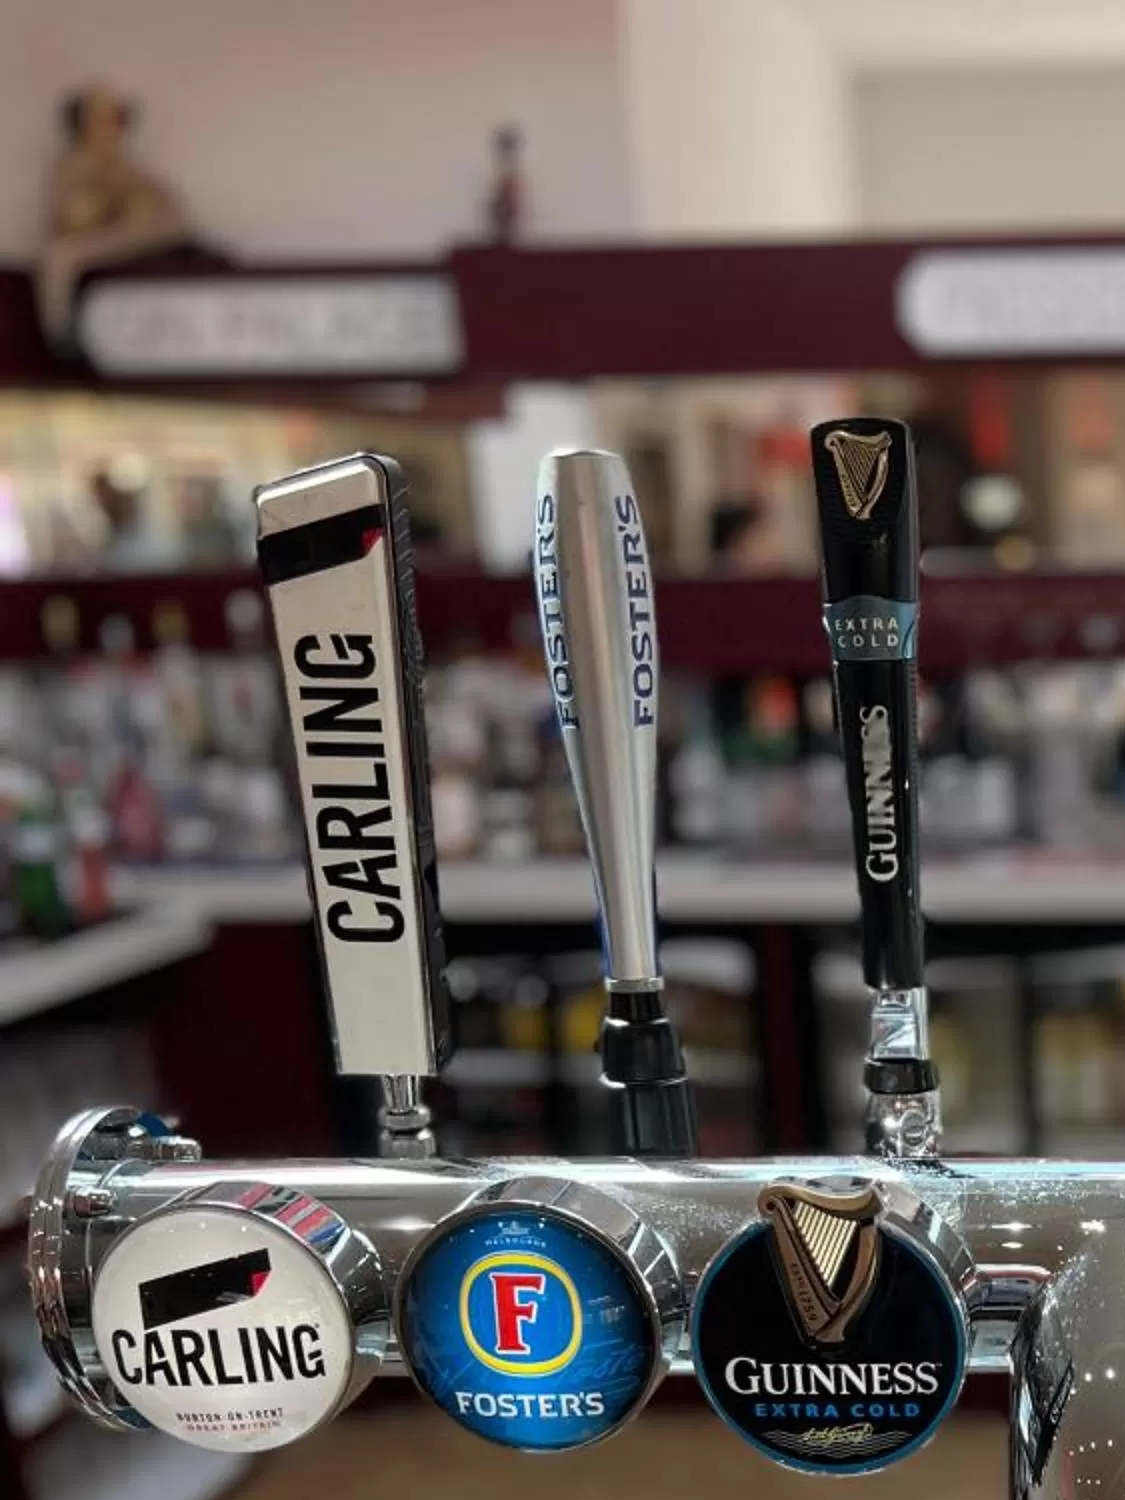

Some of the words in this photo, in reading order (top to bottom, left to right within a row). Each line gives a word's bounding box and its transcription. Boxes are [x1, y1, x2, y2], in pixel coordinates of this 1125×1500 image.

[537, 494, 579, 729] FOSTER'S
[615, 494, 655, 728] FOSTER'S
[835, 618, 898, 631] EXTRA
[837, 634, 899, 647] COLD
[293, 631, 405, 943] CARLING
[859, 705, 899, 882] GUINNS
[490, 1272, 545, 1354] F
[111, 1323, 326, 1387] CARLING
[725, 1357, 939, 1395] GUINNESS
[455, 1392, 605, 1417] FOSTER'S
[755, 1403, 839, 1417] EXTRA
[851, 1403, 921, 1417] COLD
